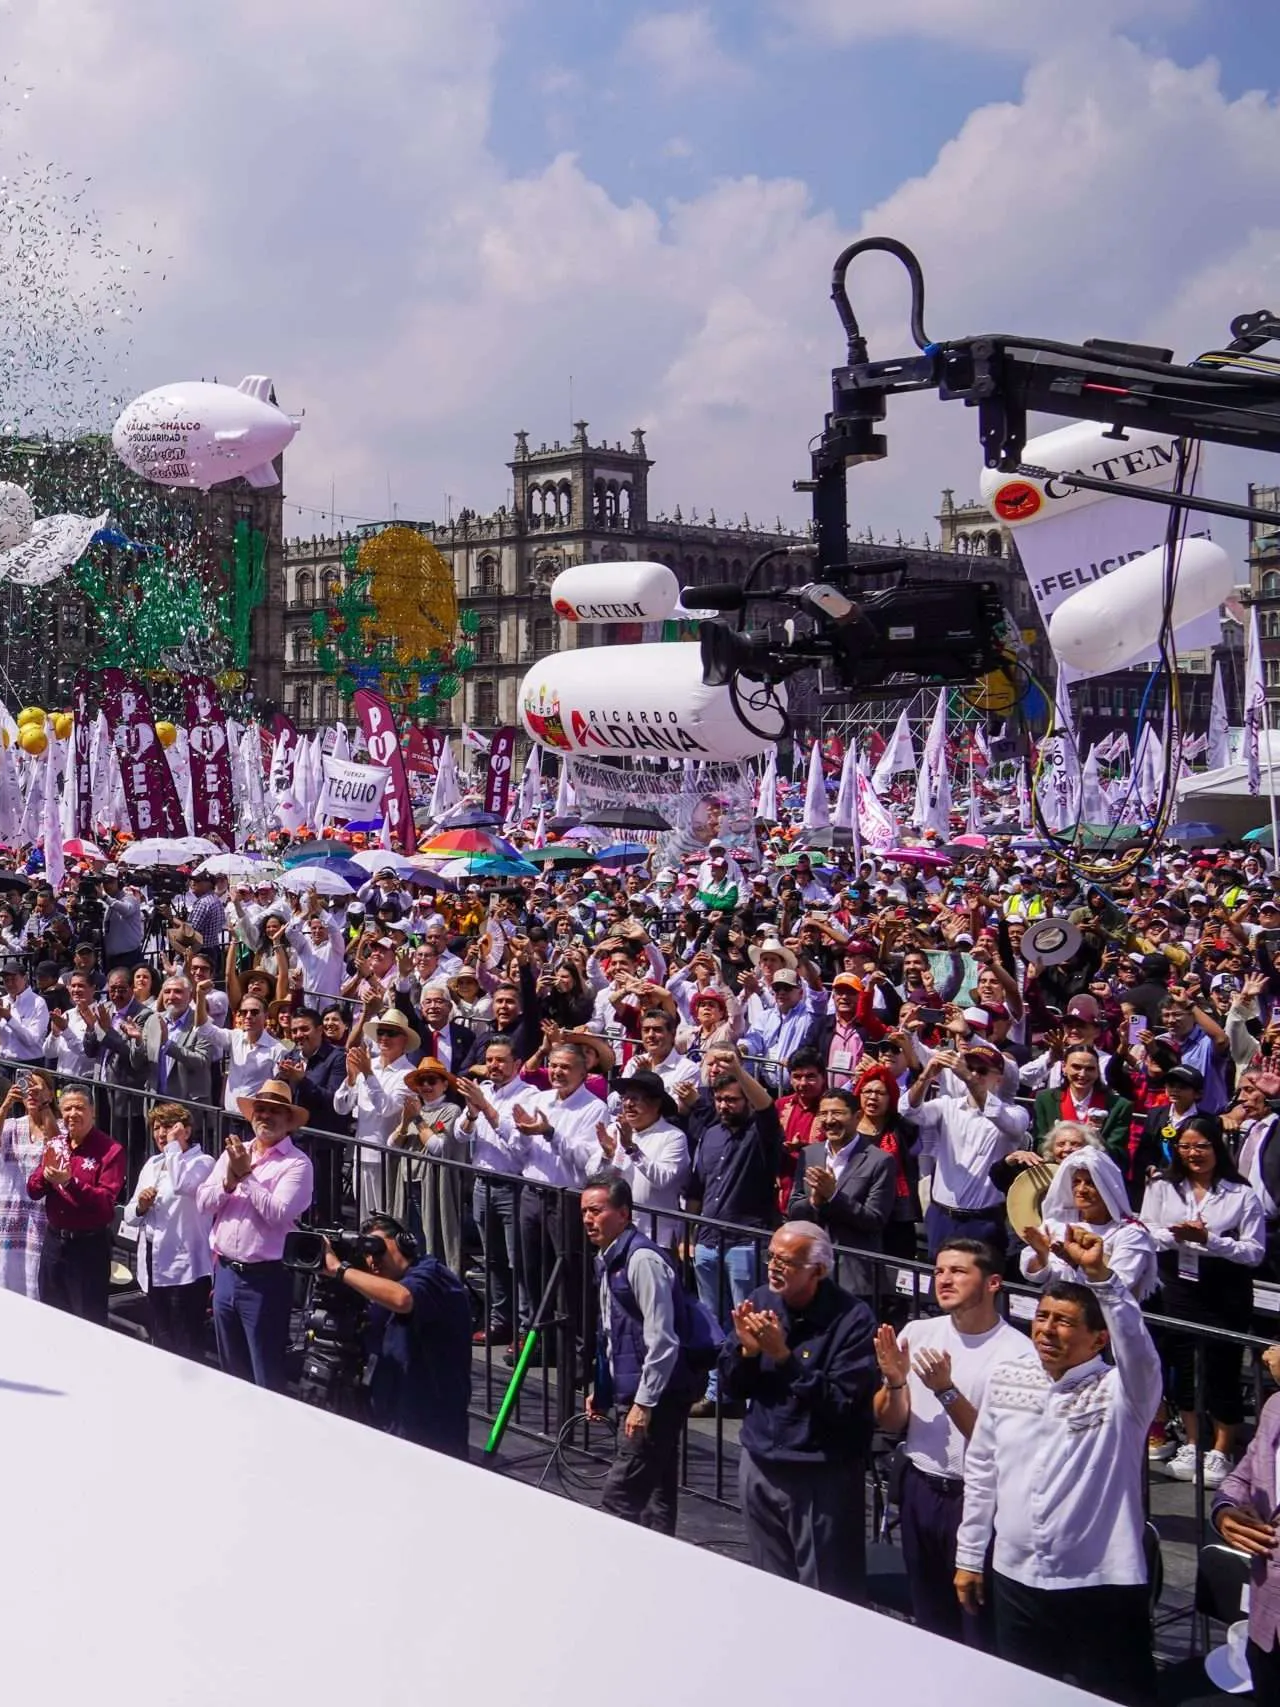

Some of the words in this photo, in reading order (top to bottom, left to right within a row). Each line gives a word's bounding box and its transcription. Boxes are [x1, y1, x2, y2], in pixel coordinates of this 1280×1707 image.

[576, 602, 647, 619] CATEM
[589, 710, 678, 724] RICARDO
[572, 711, 708, 752] ALDANA
[328, 777, 377, 803] TEQUIO
